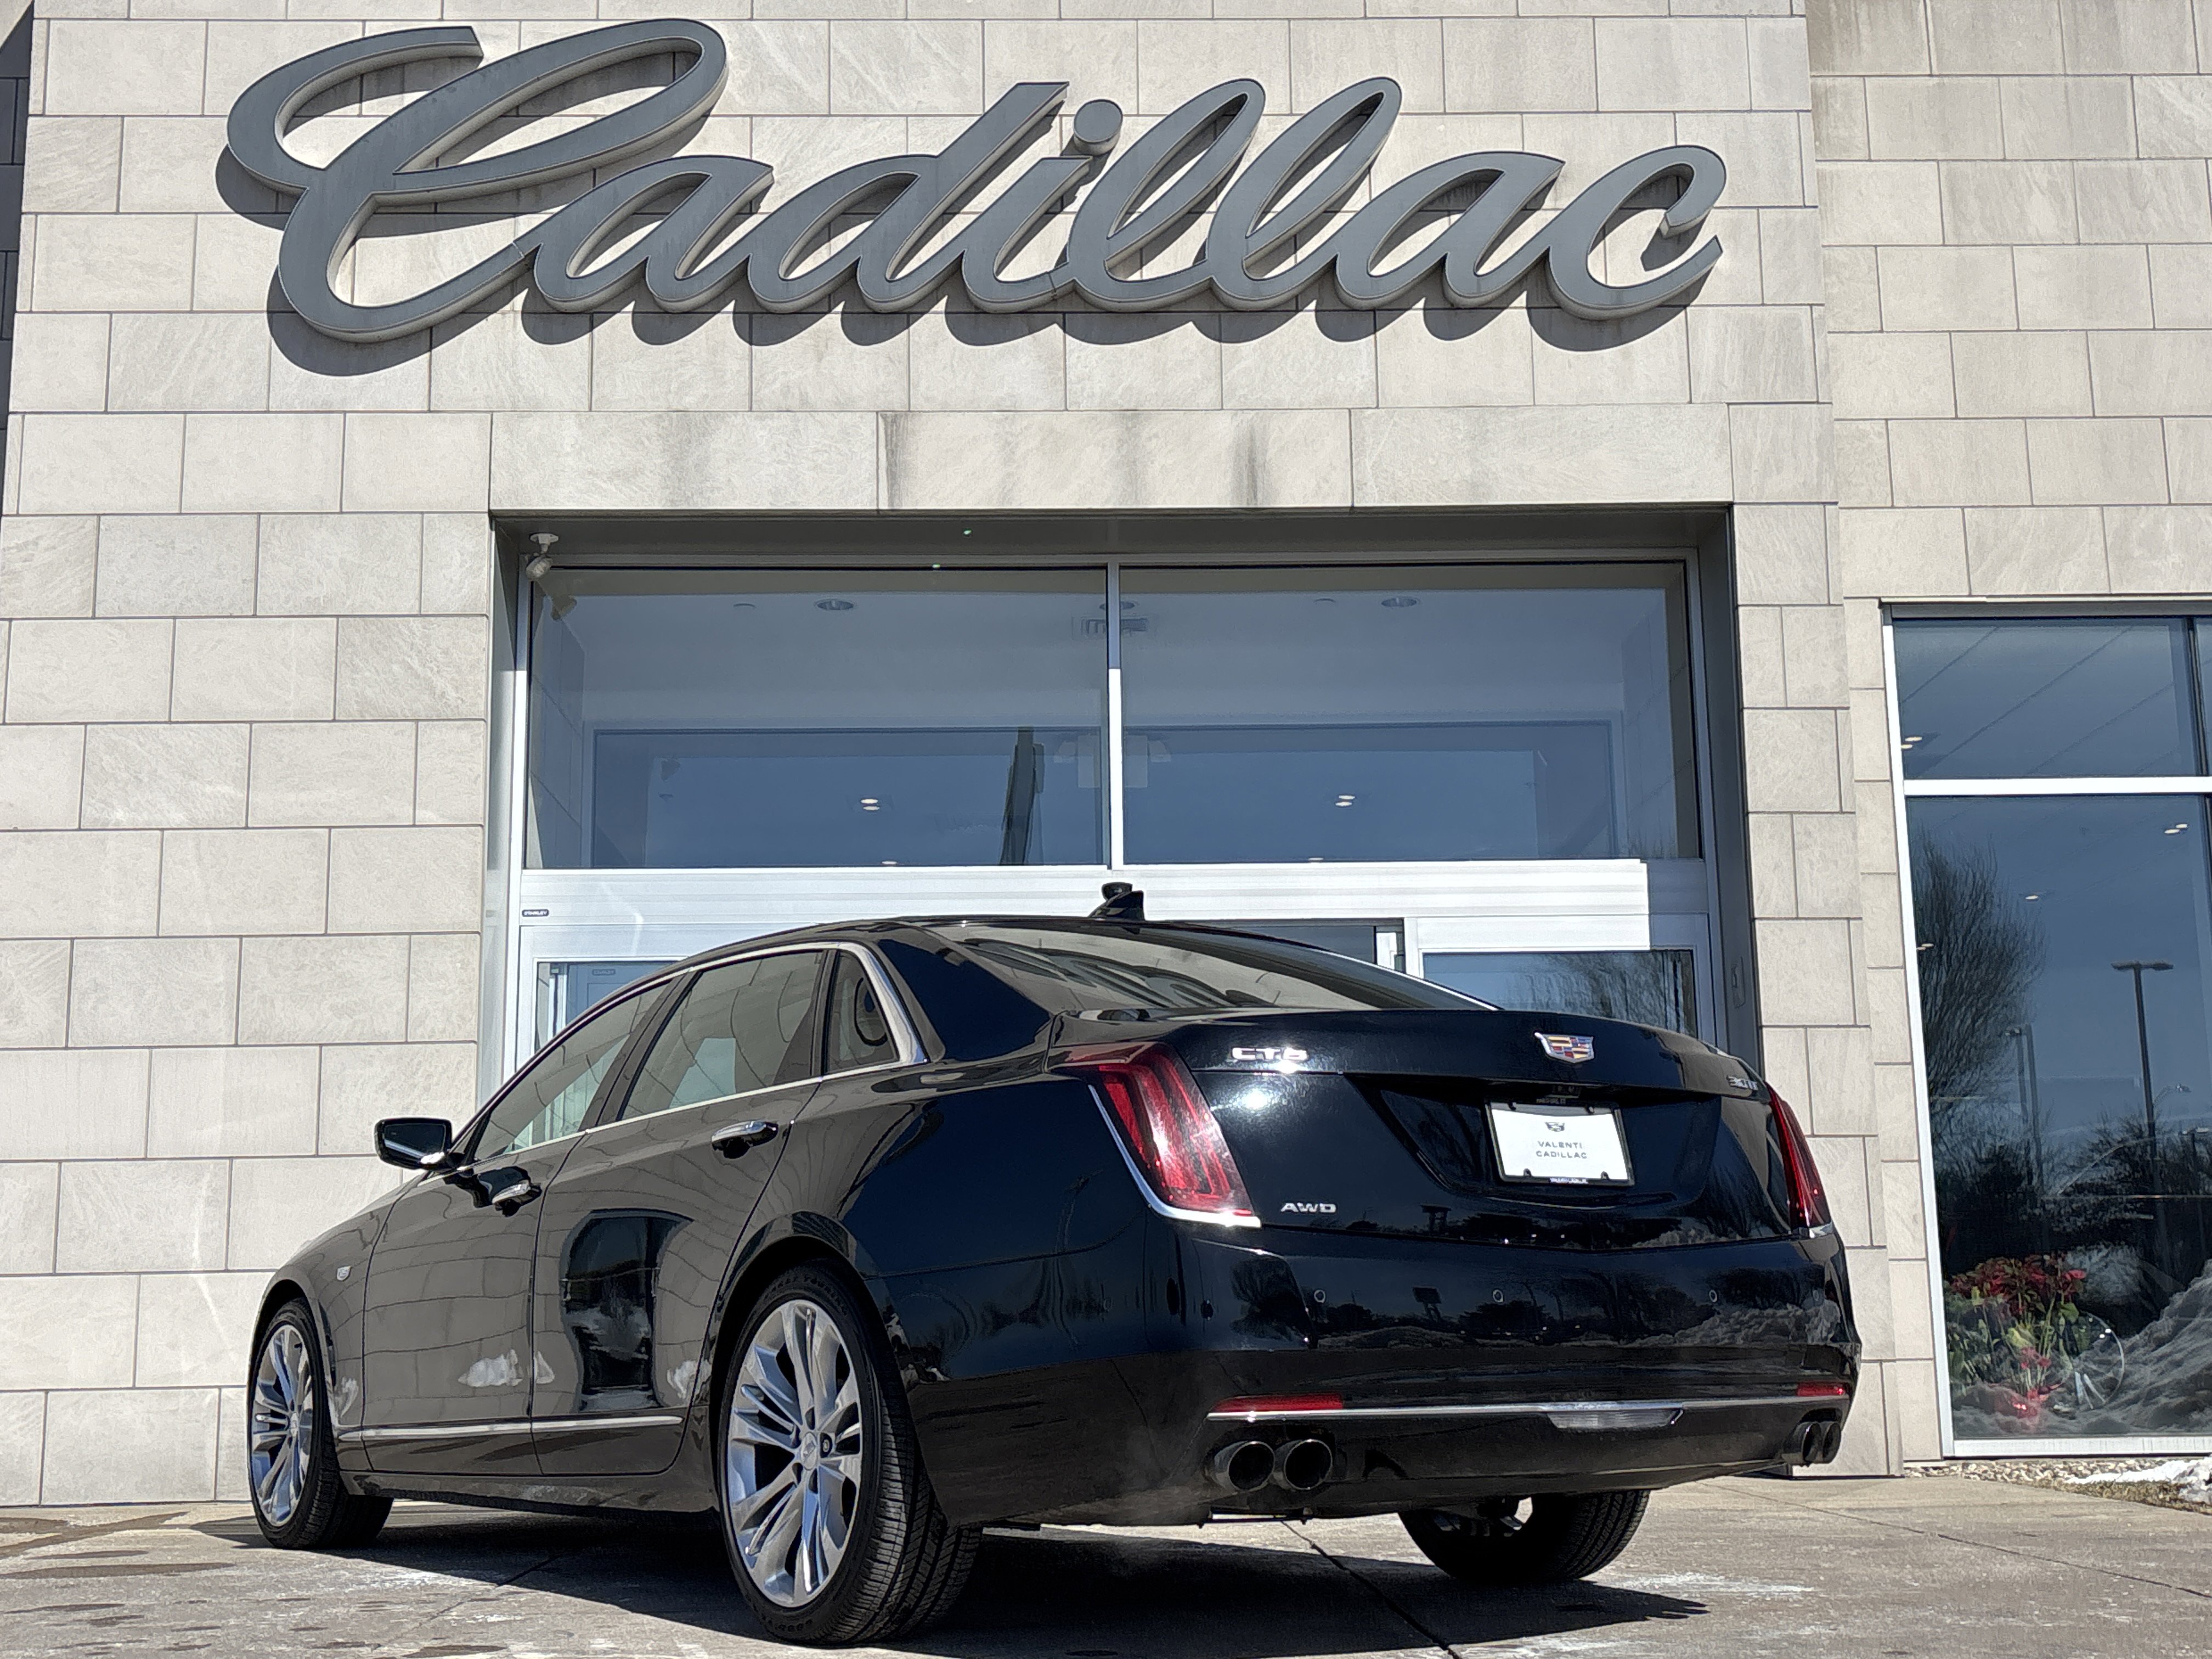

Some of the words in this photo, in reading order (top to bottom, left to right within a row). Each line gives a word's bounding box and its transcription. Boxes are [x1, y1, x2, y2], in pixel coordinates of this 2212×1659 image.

[227, 18, 1726, 343] Cadillac
[1537, 1141, 1582, 1149] VALENTI
[1536, 1150, 1587, 1159] CADILLAC
[1280, 1202, 1336, 1213] AWD
